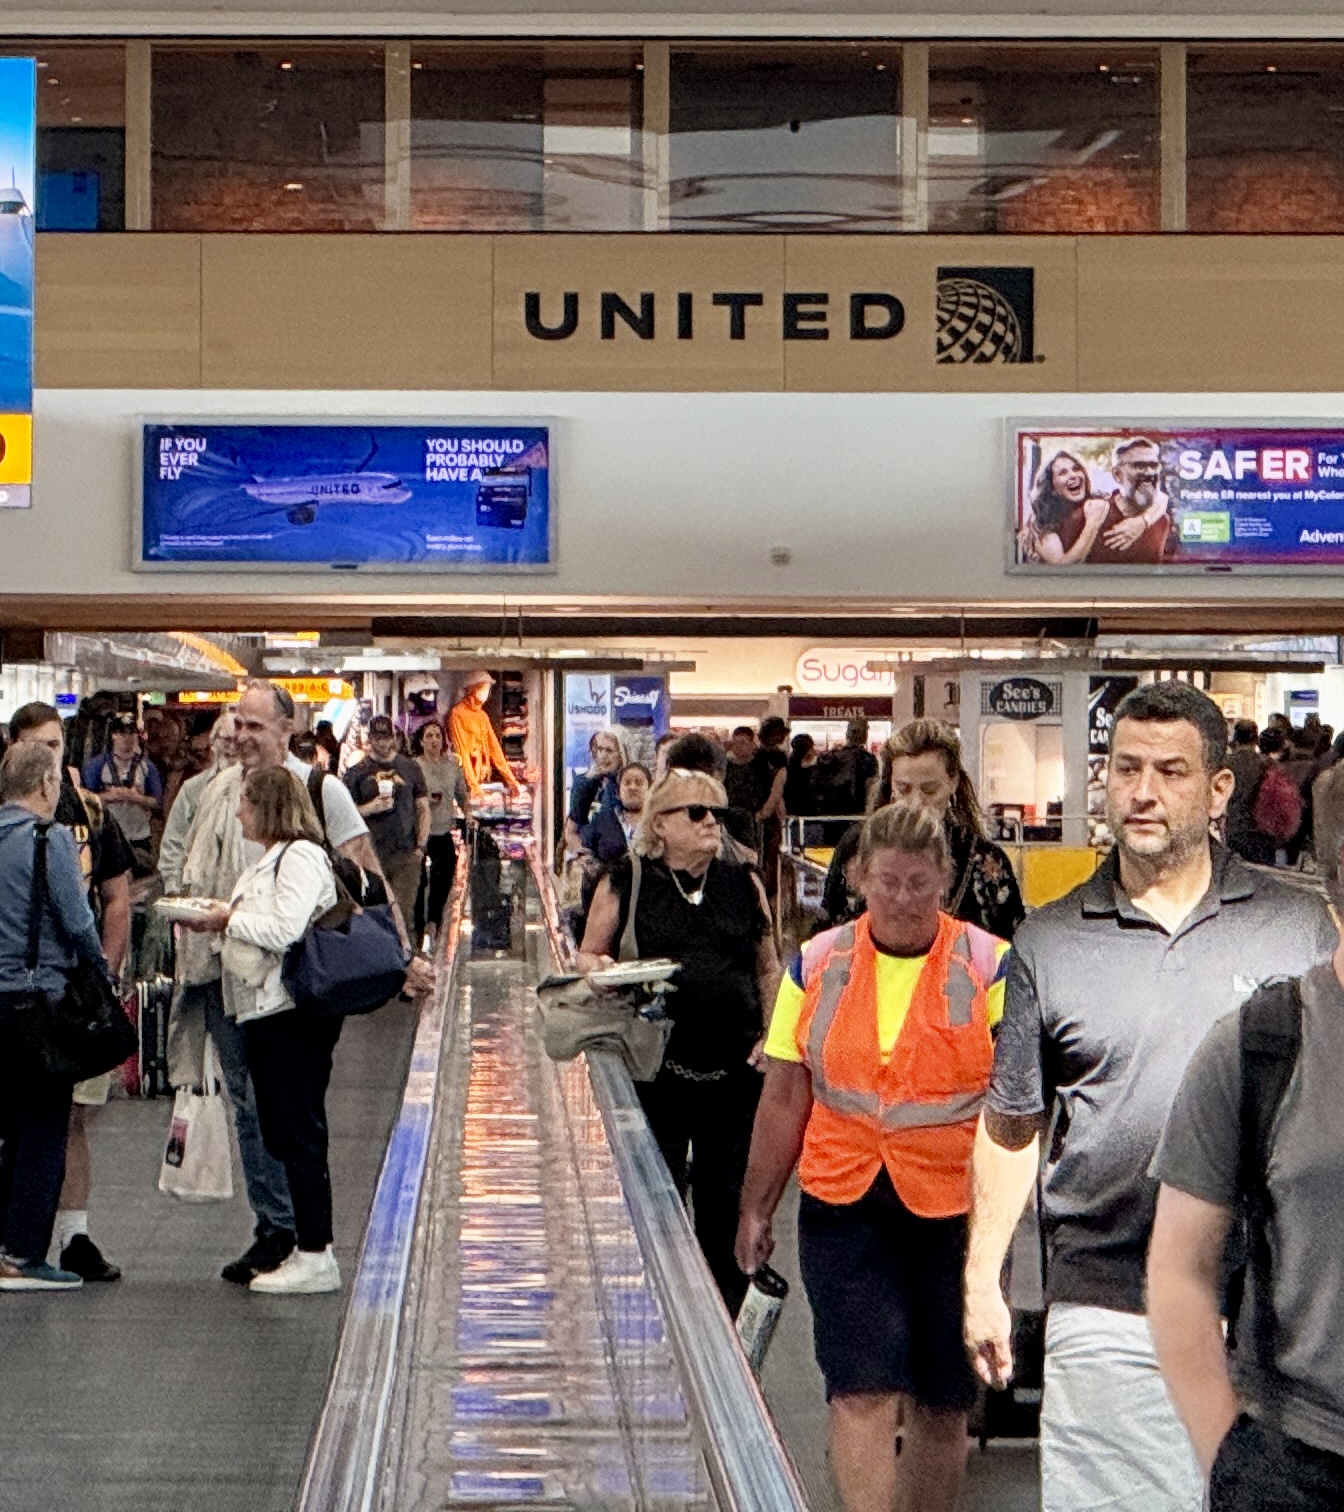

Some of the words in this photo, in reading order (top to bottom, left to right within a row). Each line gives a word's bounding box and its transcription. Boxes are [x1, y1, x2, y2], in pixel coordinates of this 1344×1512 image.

[523, 291, 907, 341] UNITED
[159, 437, 173, 451] IF
[174, 437, 207, 453] YOU
[425, 438, 459, 453] YOU
[460, 438, 525, 454] SHOULD
[159, 452, 199, 466] EVER
[425, 453, 505, 467] PROBABLY
[1177, 449, 1311, 481] SAFER
[1317, 452, 1339, 465] For
[159, 466, 183, 480] FLY
[425, 467, 469, 482] HAVE
[1235, 490, 1272, 500] nearest
[1273, 491, 1292, 503] you
[1292, 491, 1303, 500] at
[1002, 682, 1042, 699] See's
[996, 700, 1047, 713] CANDIES
